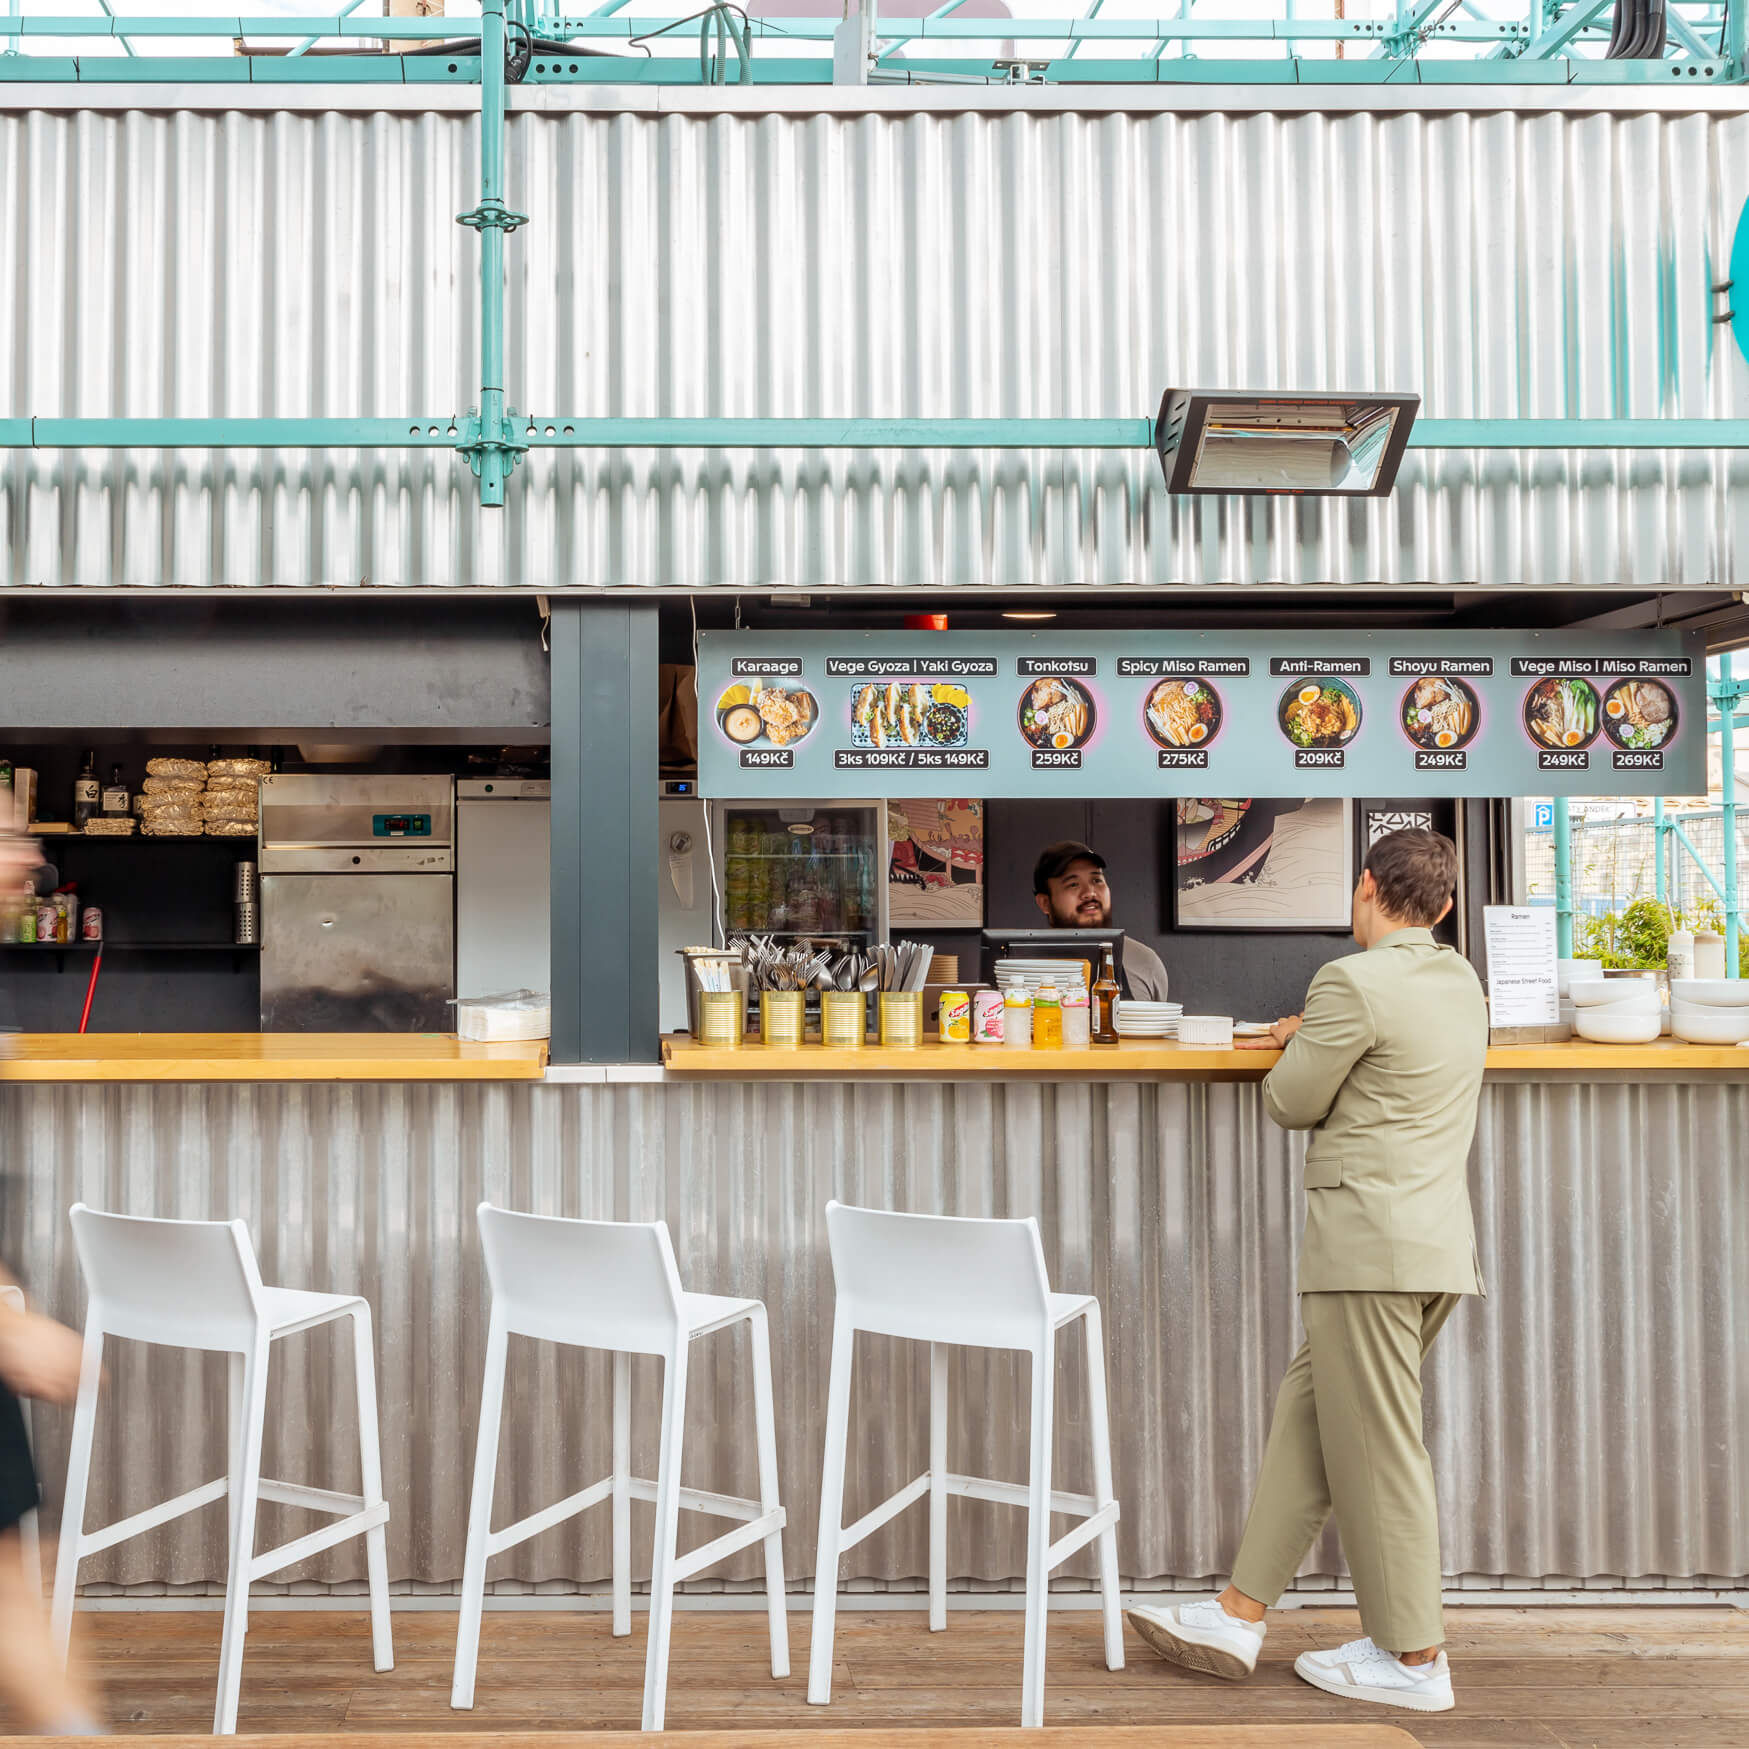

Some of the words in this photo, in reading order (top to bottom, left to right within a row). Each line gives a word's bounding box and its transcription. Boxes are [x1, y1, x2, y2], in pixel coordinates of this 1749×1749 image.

[737, 660, 799, 675] Karaage
[829, 660, 865, 675] Vege
[867, 660, 910, 675] Gyoza
[920, 660, 949, 672] Yaki
[951, 660, 994, 675] Gyoza
[1025, 660, 1089, 672] Tonkotsu
[1121, 660, 1160, 675] Spicy
[1162, 660, 1196, 672] Miso
[1198, 660, 1247, 672] Ramen
[1279, 660, 1361, 672] Anti-Ramen
[1393, 660, 1438, 675] Shoyu
[1440, 660, 1490, 672] Ramen
[1518, 660, 1555, 675] Vege
[1558, 660, 1592, 672] Miso
[1602, 660, 1636, 672] Miso
[1639, 660, 1688, 672] Ramen
[745, 751, 789, 765] 149Kč
[838, 753, 863, 765] 3ks
[865, 752, 906, 765] 109Kč
[917, 753, 942, 765] 5ks
[944, 752, 985, 765] 149Kč
[1035, 752, 1079, 765] 259Kč
[1162, 752, 1206, 765] 275Kč
[1298, 751, 1342, 765] 209Kč
[1418, 752, 1463, 766] 249Kč
[1541, 752, 1586, 766] 249Kč
[1616, 752, 1660, 766] 269Kč
